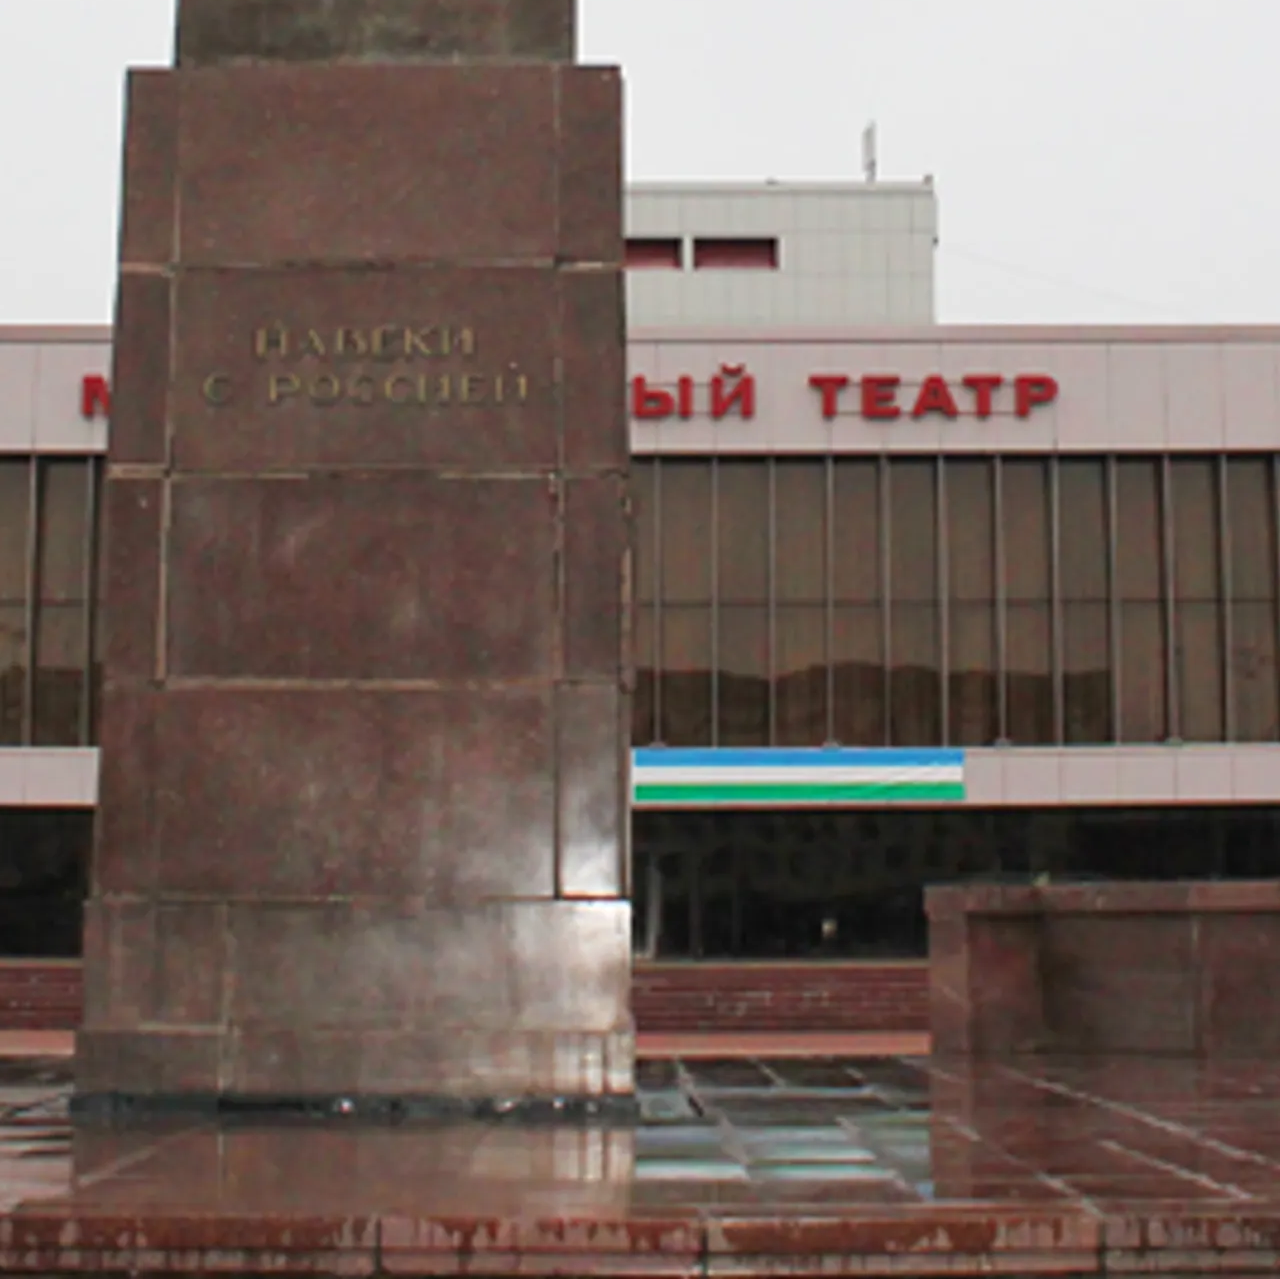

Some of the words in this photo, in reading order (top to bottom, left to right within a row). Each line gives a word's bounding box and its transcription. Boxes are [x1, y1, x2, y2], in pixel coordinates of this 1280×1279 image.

[253, 323, 476, 358] НАВЕКИ
[201, 370, 233, 403] С
[268, 365, 530, 404] РОССИЕЙ
[808, 373, 1059, 419] ТЕАТР
